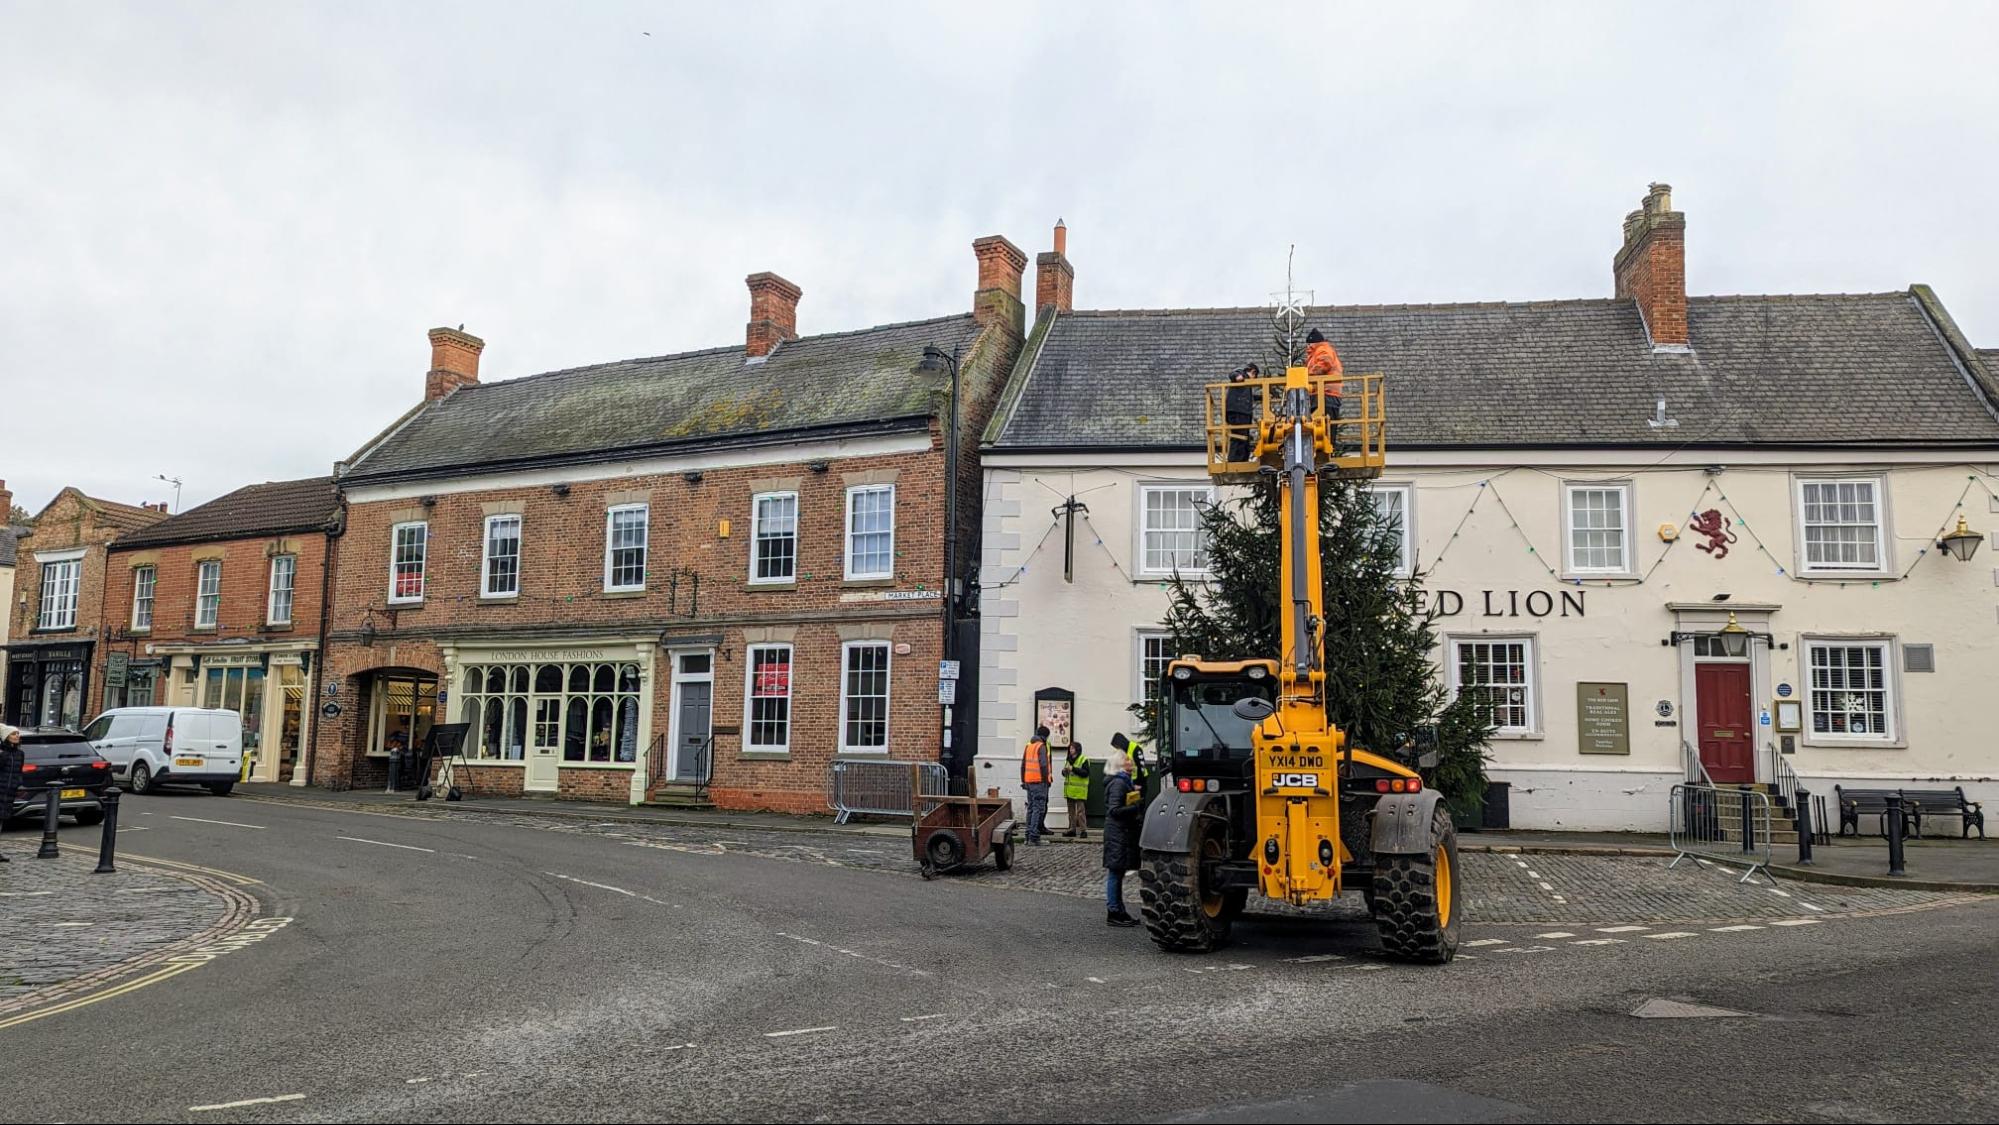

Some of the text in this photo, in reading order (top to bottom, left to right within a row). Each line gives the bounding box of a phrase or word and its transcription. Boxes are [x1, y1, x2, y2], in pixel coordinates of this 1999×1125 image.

[888, 591, 939, 600] MARKET PLACE
[1411, 590, 1586, 617] ED LION
[491, 649, 604, 660] LONDON HOUSE FASHIONS
[1269, 756, 1323, 767] YX14 DWO
[1272, 773, 1317, 787] JCB
